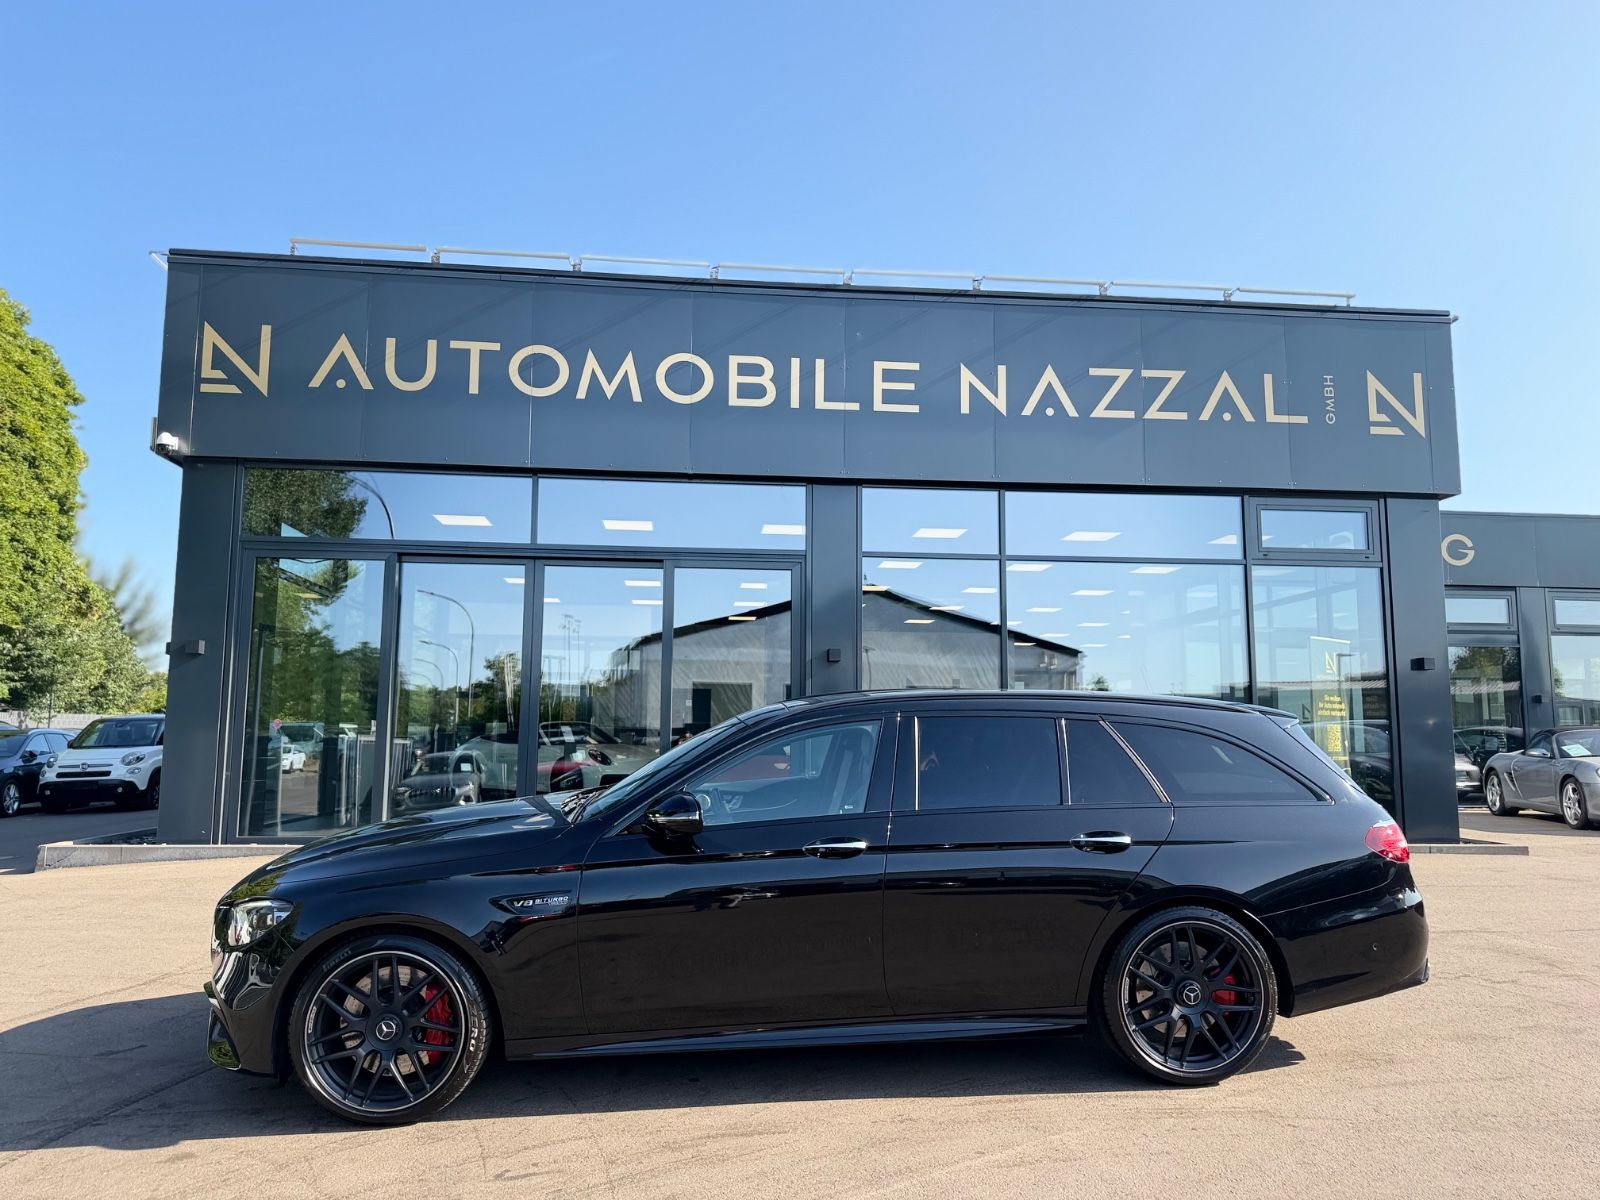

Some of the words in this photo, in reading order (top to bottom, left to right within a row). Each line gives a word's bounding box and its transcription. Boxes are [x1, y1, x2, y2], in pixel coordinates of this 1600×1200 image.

[309, 334, 919, 412] AUTOMOBILE
[961, 363, 1308, 423] NAZZAL
[1324, 376, 1335, 424] GMBH
[513, 899, 533, 907] V8
